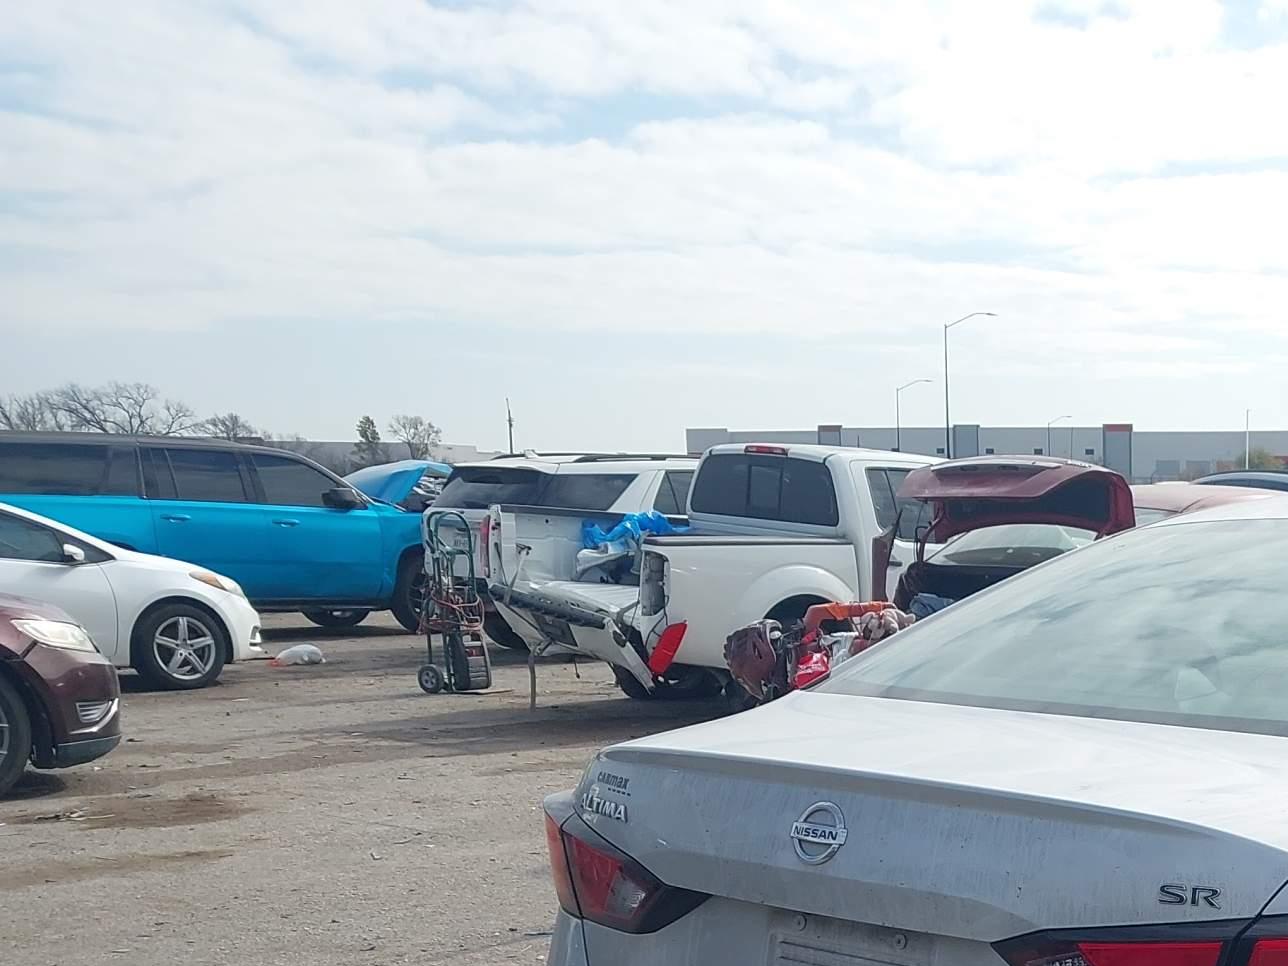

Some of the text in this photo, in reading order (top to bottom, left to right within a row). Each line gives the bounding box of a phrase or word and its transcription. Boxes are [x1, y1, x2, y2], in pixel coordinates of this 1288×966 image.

[581, 793, 628, 822] ALTIMA
[793, 825, 838, 841] NISSAN
[1158, 884, 1222, 909] SR
